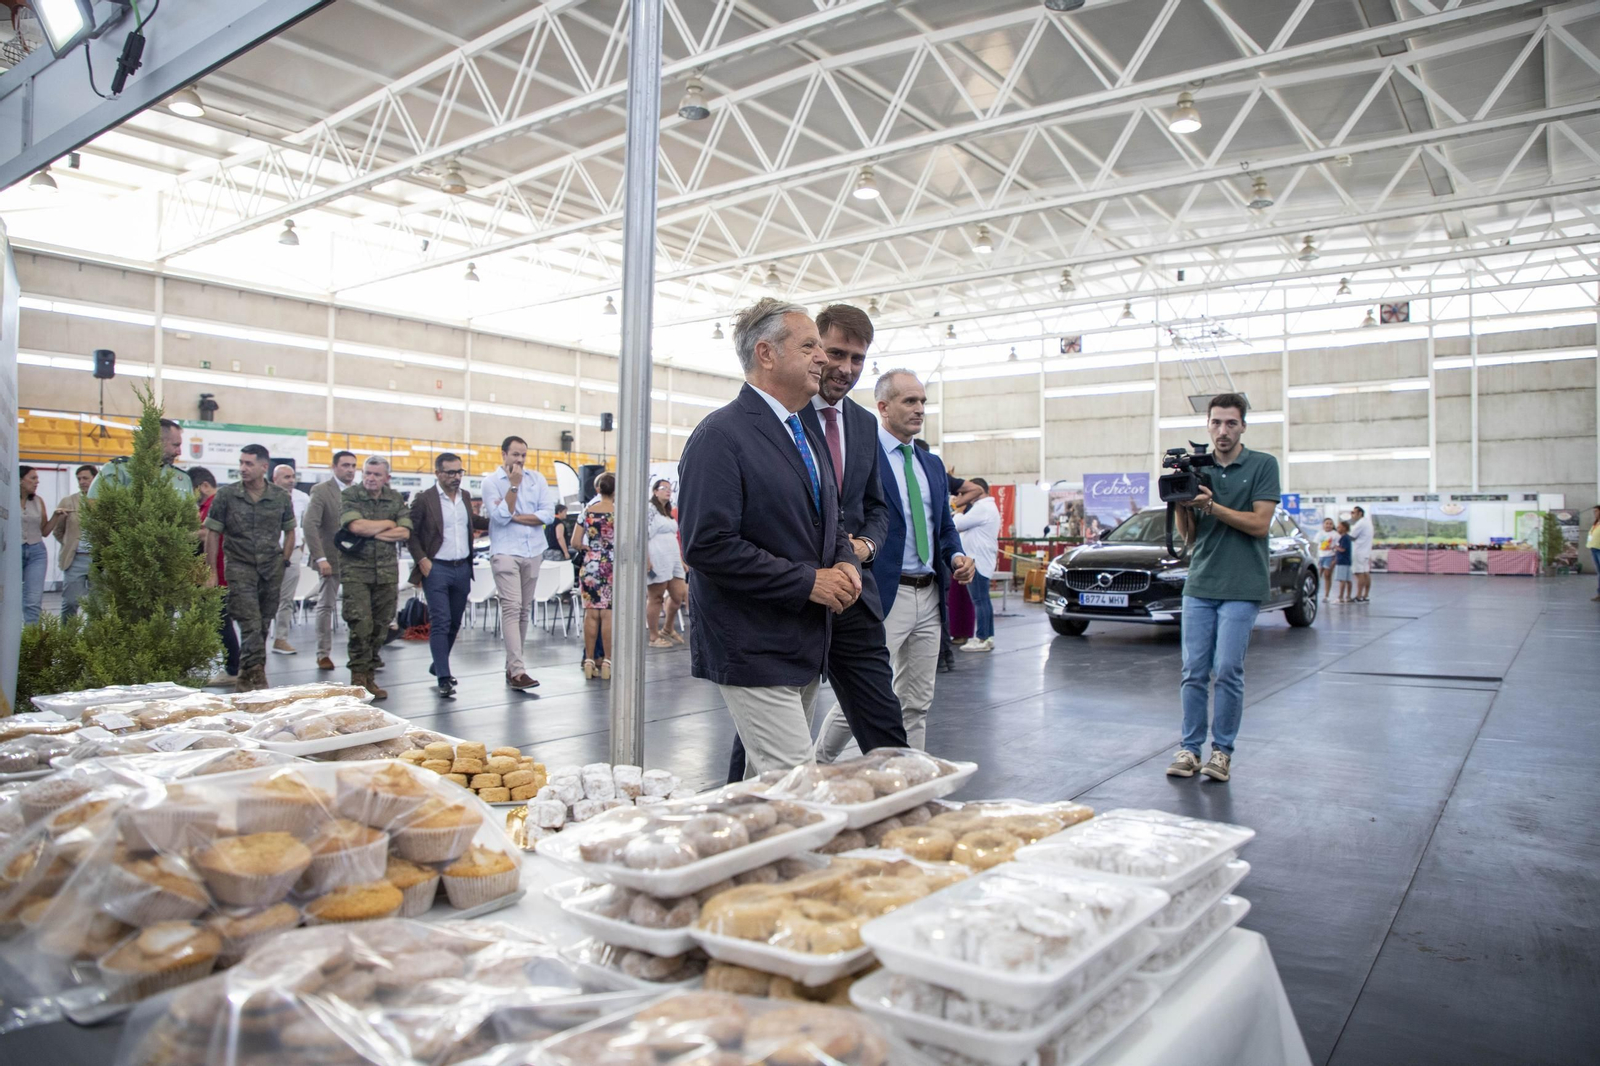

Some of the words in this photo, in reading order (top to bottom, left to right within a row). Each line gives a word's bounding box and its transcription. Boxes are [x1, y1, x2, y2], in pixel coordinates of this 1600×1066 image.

[1090, 477, 1148, 499] Cetrecor
[1085, 595, 1106, 605] 8774
[1108, 596, 1126, 606] MHV
